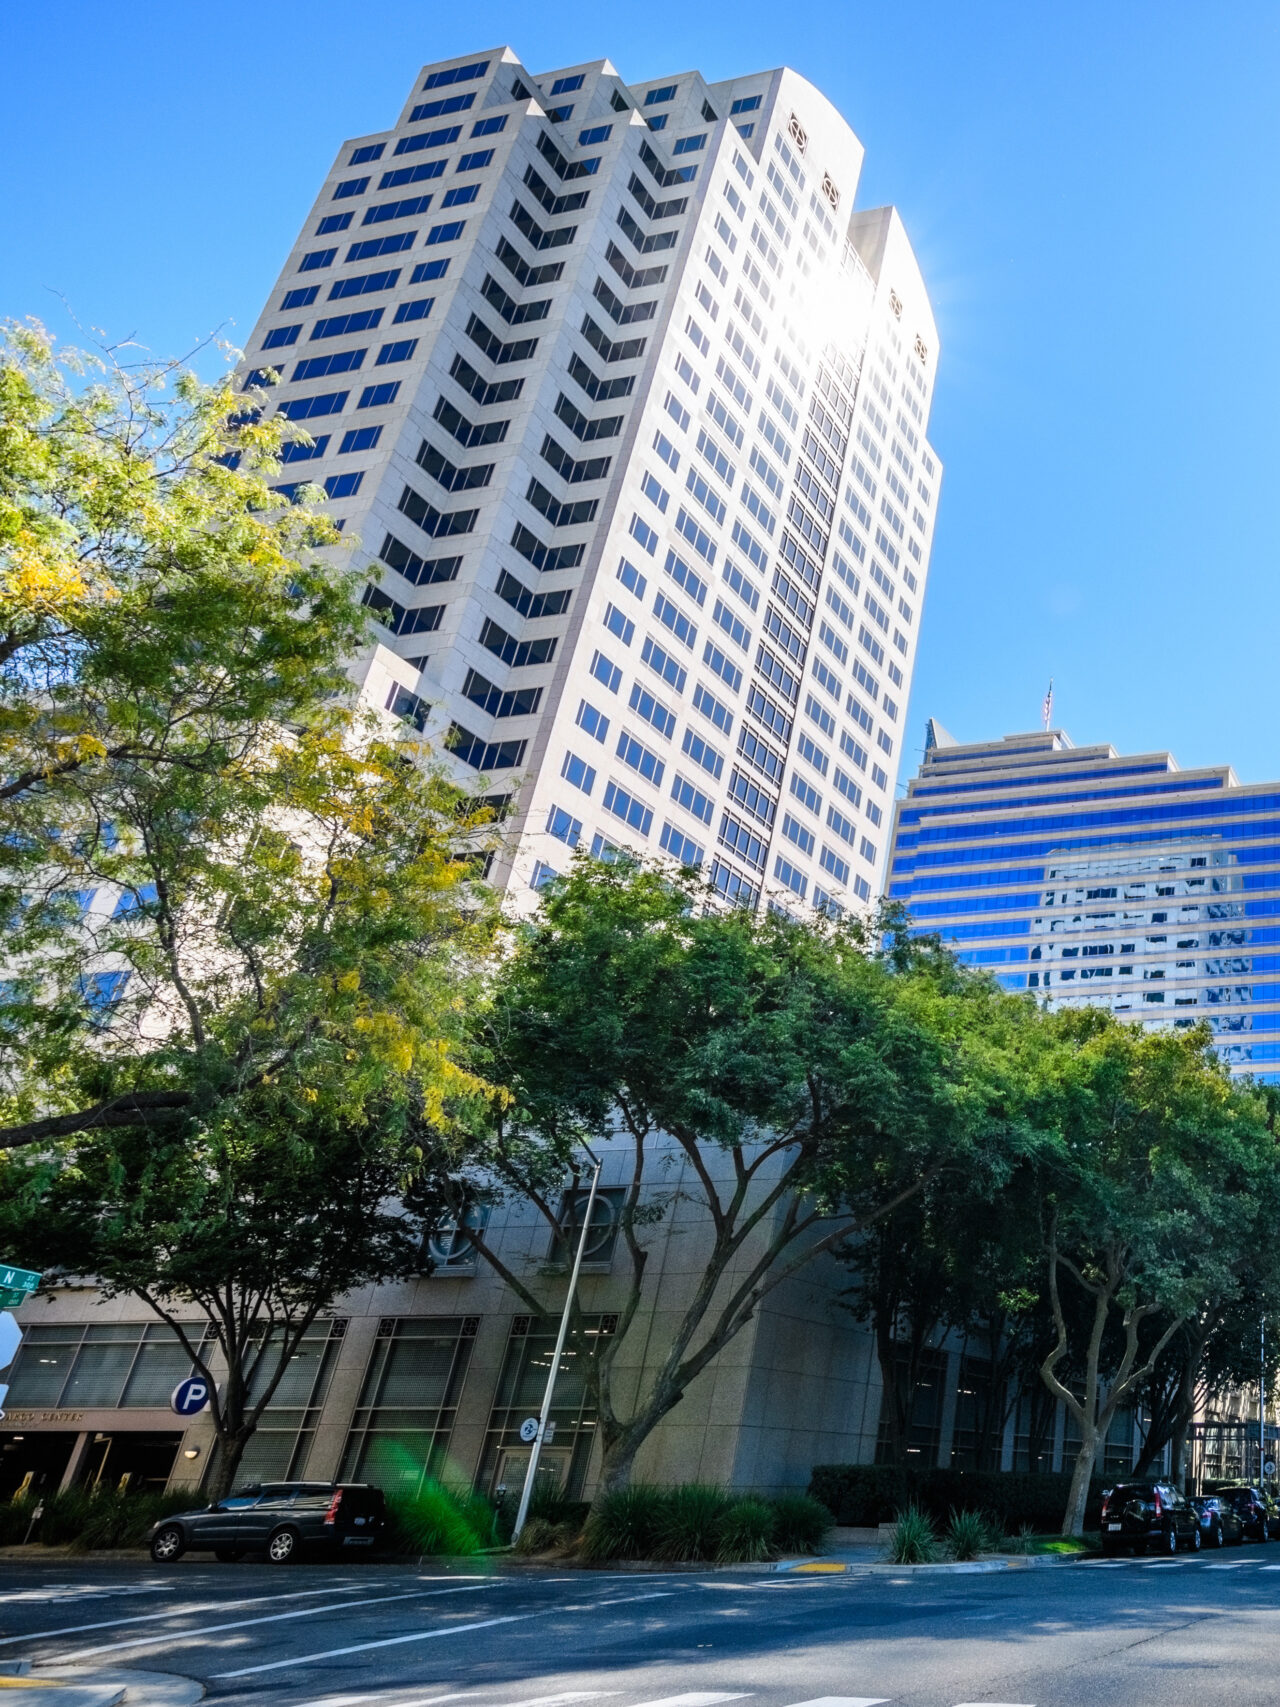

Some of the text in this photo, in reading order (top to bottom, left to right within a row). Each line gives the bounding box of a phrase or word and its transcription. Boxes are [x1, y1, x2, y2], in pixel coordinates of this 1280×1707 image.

[3, 1270, 16, 1284] N
[182, 1384, 206, 1410] P
[41, 1411, 84, 1422] CENTER
